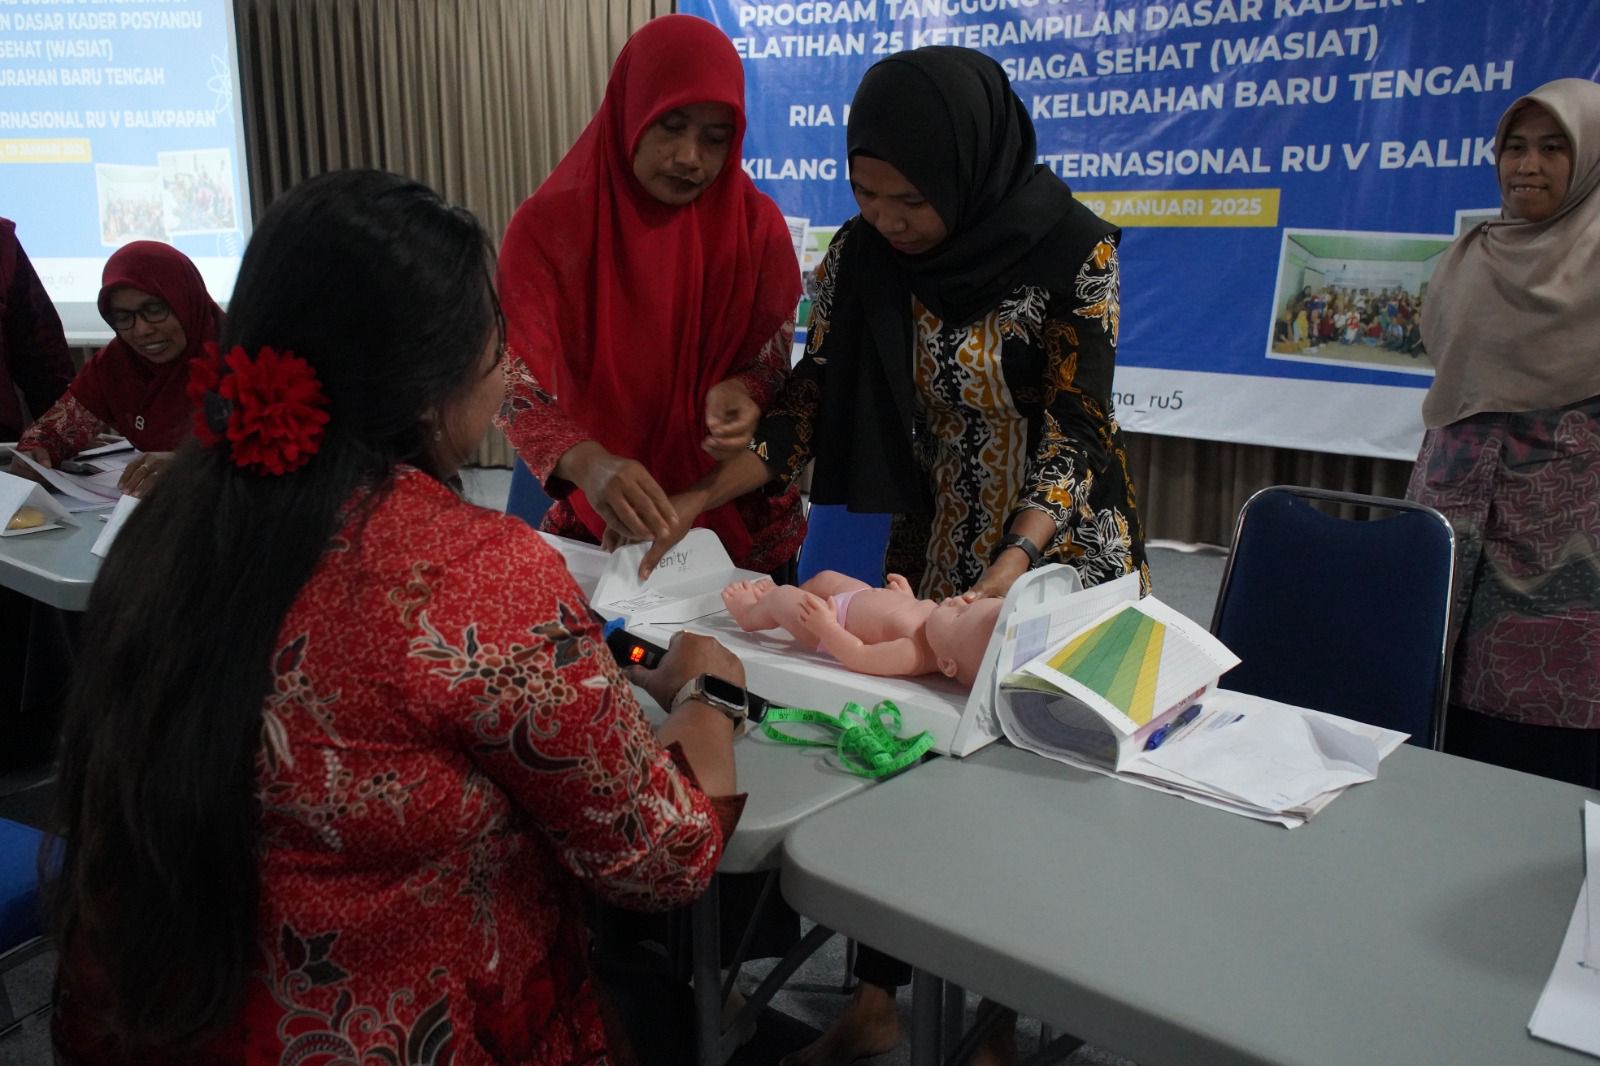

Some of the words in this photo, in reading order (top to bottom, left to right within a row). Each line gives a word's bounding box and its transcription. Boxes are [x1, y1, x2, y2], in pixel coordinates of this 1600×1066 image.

[15, 12, 64, 30] DASAR
[68, 11, 117, 30] KADER
[121, 10, 201, 29] POSYANDU
[739, 0, 877, 28] PROGRAM
[873, 31, 903, 54] 25
[912, 8, 1136, 49] KETERAMPILAN
[1145, 0, 1262, 32] DASAR
[46, 38, 113, 62] (WASIAT)
[1001, 52, 1088, 82] SIAGA
[1096, 41, 1201, 75] SEHAT
[1210, 24, 1379, 73] (WASIAT)
[61, 68, 102, 86] BARU
[104, 67, 165, 85] TENGAH
[789, 104, 836, 127] RIA
[1032, 84, 1225, 120] KELURAHAN
[1235, 75, 1338, 108] BARU
[1349, 60, 1514, 101] TENGAH
[86, 110, 107, 129] RU
[109, 110, 121, 128] V
[124, 109, 216, 128] BALIKPAPAN
[741, 158, 838, 181] KILANG
[1281, 144, 1332, 173] RU
[1342, 142, 1371, 170] V
[1110, 197, 1204, 216] JANUARI
[1211, 197, 1262, 216] 2025
